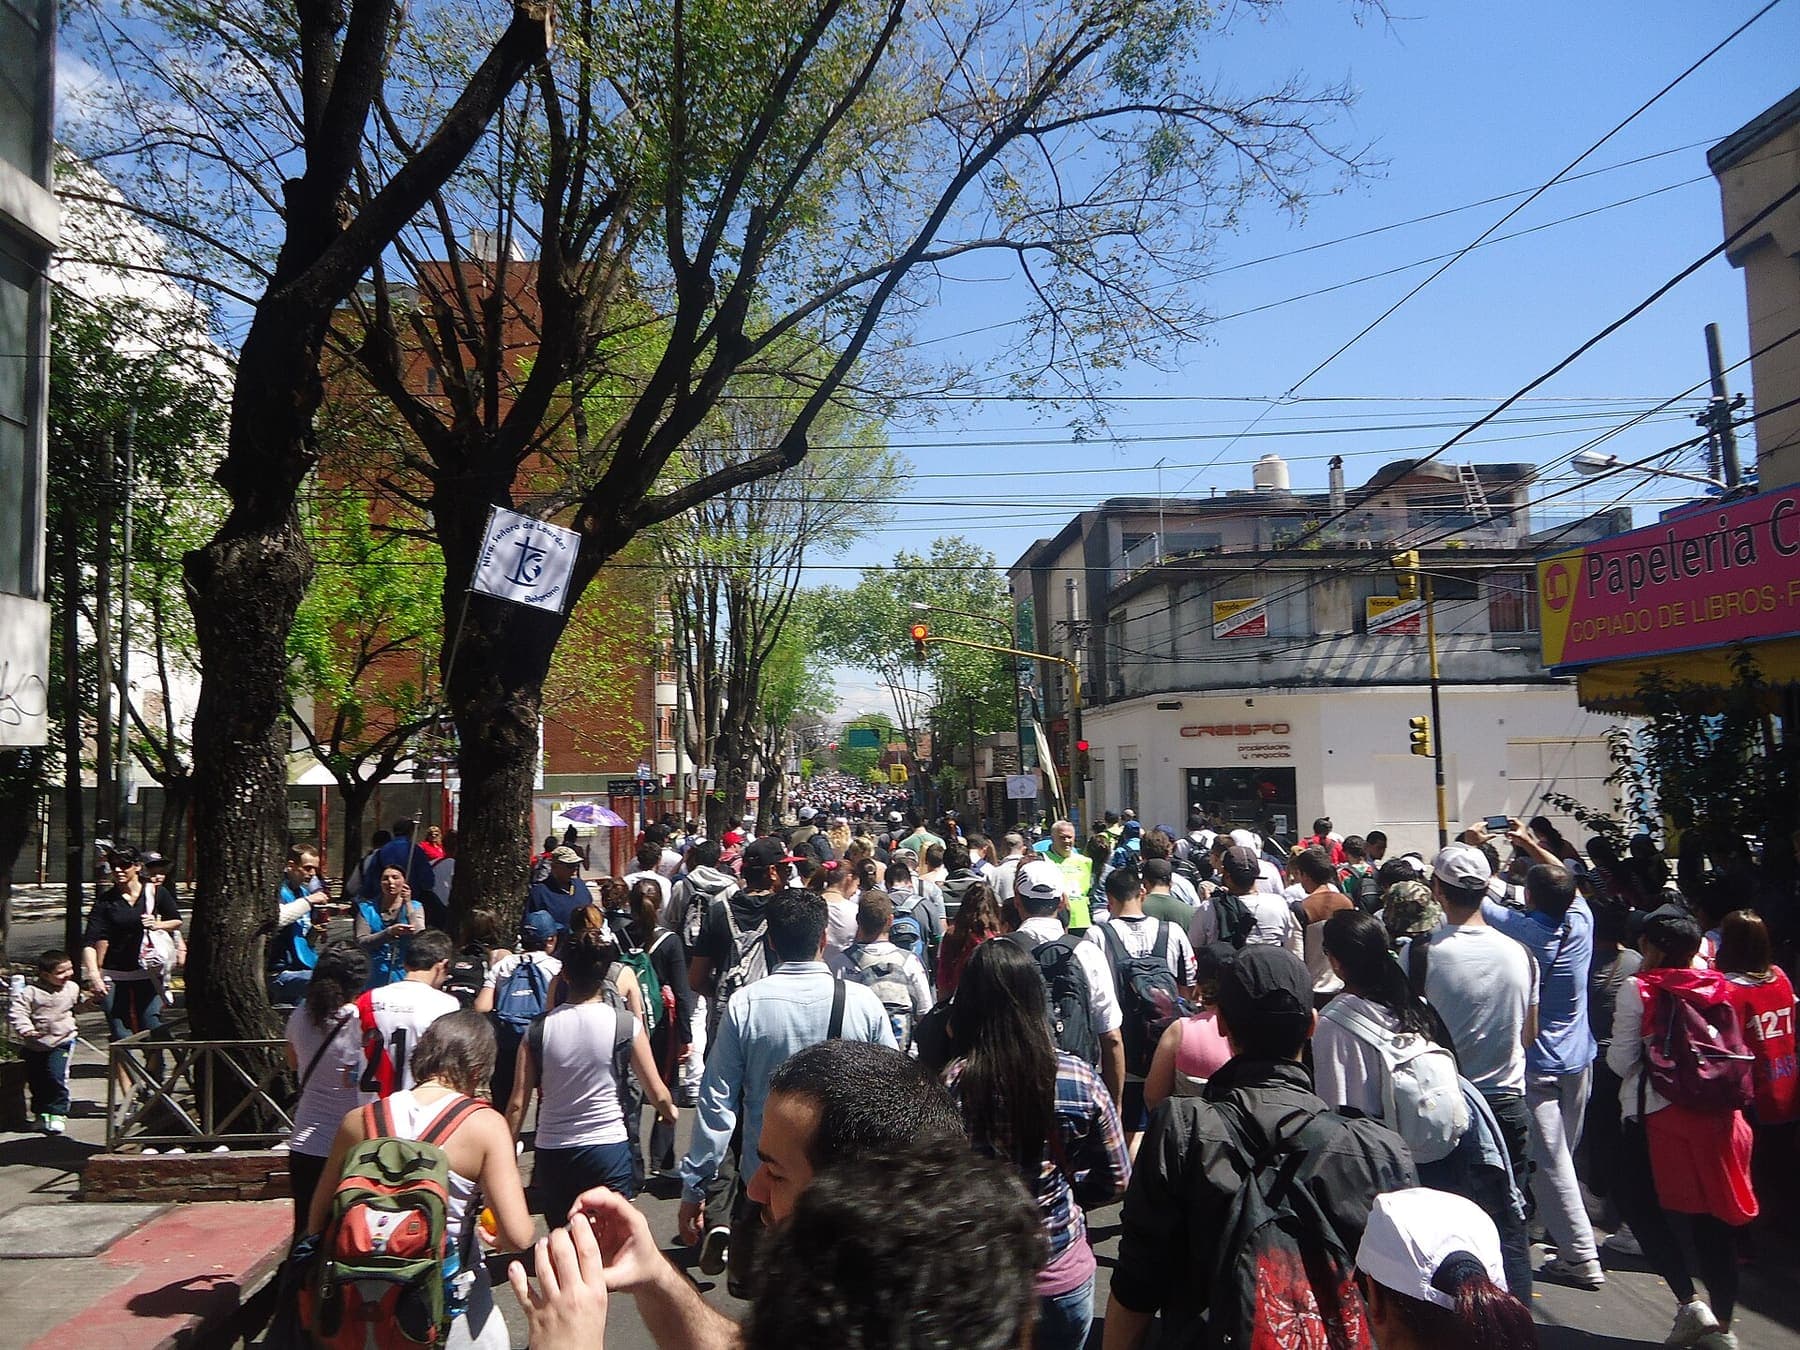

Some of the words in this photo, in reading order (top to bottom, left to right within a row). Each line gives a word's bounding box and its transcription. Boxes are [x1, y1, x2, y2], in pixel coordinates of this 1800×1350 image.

[523, 521, 535, 530] de
[537, 524, 566, 550] Lourdes
[1587, 514, 1757, 604] Papeleria
[1571, 608, 1653, 643] COPIADO
[1658, 602, 1686, 629] DE
[1692, 584, 1777, 624] LIBROS
[1180, 724, 1290, 737] CRESPO
[1747, 1007, 1791, 1040] 127
[360, 1028, 406, 1092] 21
